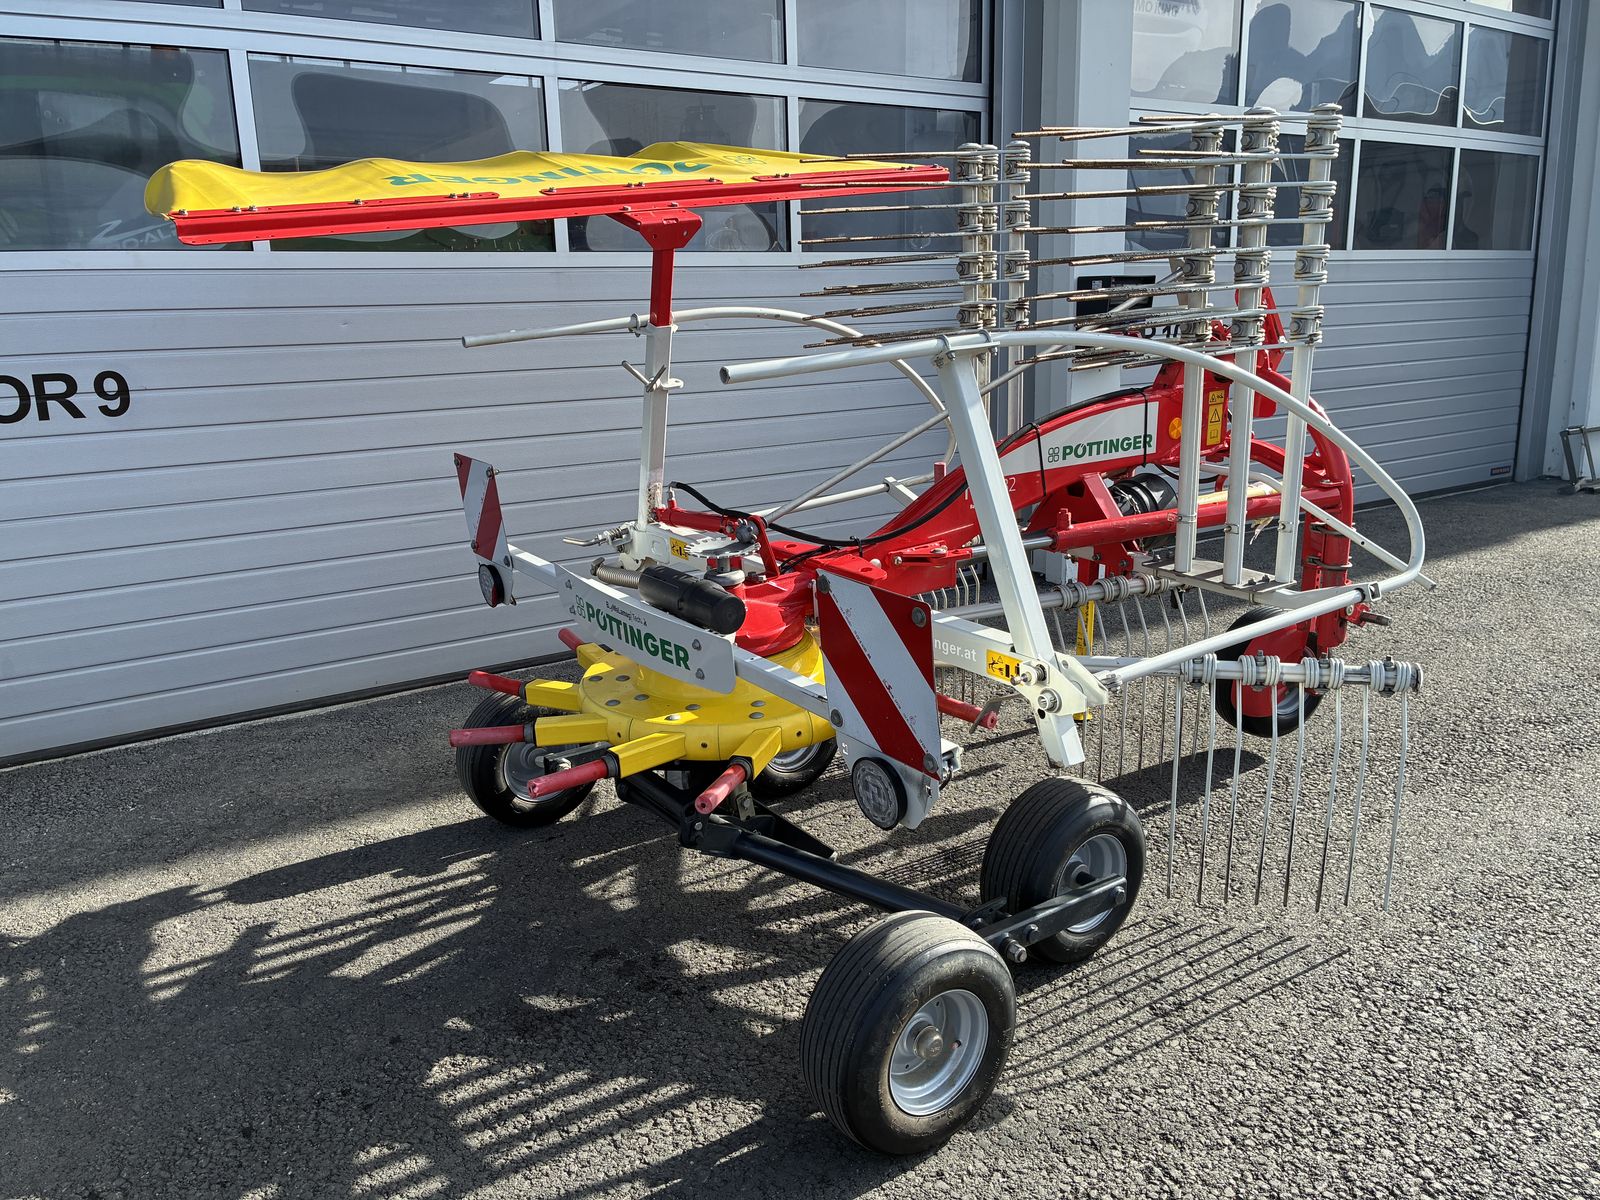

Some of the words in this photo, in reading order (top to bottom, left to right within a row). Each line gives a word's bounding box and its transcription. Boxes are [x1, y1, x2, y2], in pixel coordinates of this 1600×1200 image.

[93, 370, 130, 417] 9
[1061, 434, 1153, 461] PÖTTINGER
[585, 601, 691, 671] PÖTTINGER
[934, 638, 977, 662] nger.at
